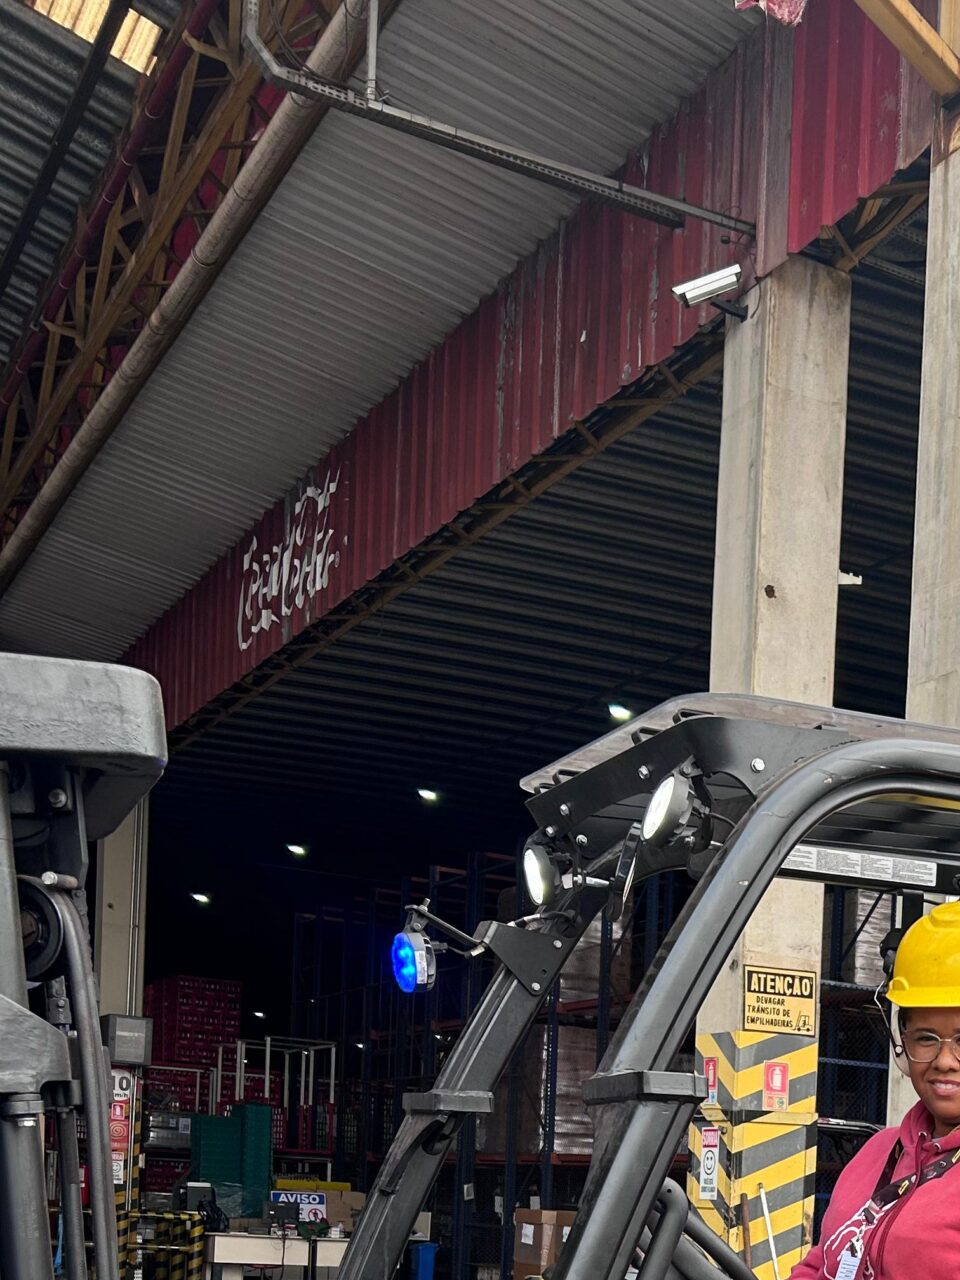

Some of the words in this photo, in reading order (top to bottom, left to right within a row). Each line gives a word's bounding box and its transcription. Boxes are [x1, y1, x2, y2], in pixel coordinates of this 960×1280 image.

[750, 972, 811, 996] ATENÇÃO
[756, 995, 785, 1006] DEVAGAR
[782, 1009, 791, 1017] DE
[746, 1015, 793, 1028] EMPILHADEIRAS
[279, 1193, 319, 1204] AVISO
